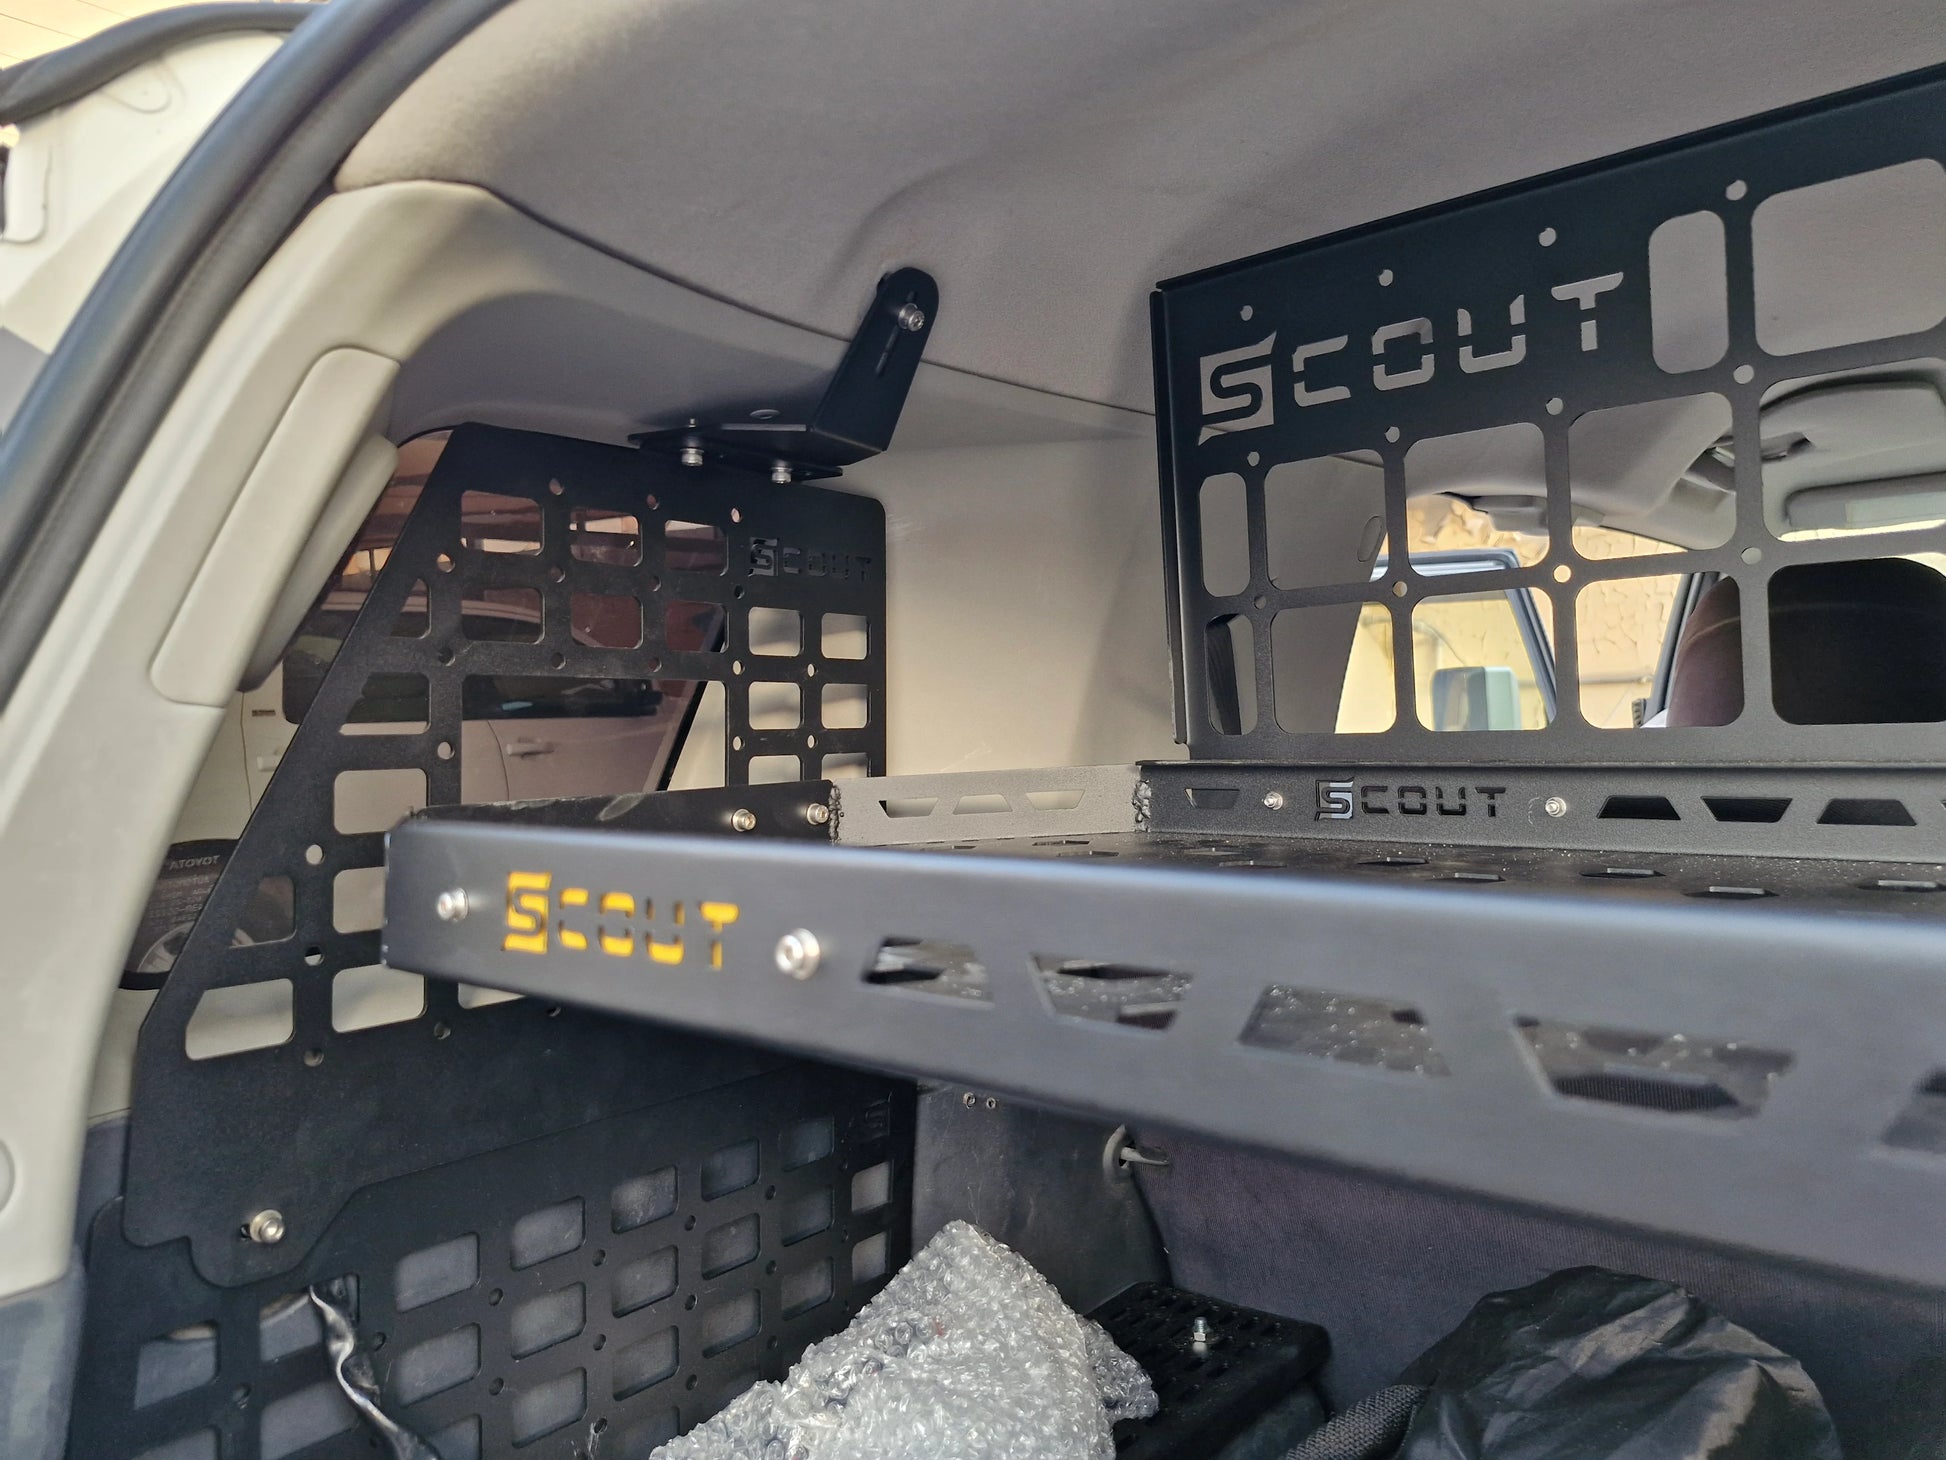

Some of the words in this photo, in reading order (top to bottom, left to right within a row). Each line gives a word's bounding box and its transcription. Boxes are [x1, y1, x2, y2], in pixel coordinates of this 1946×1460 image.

[1199, 271, 1624, 446] SCOUT
[748, 537, 872, 582] SCOUT
[1315, 777, 1506, 822] SCOUT
[502, 870, 741, 970] SCOUT
